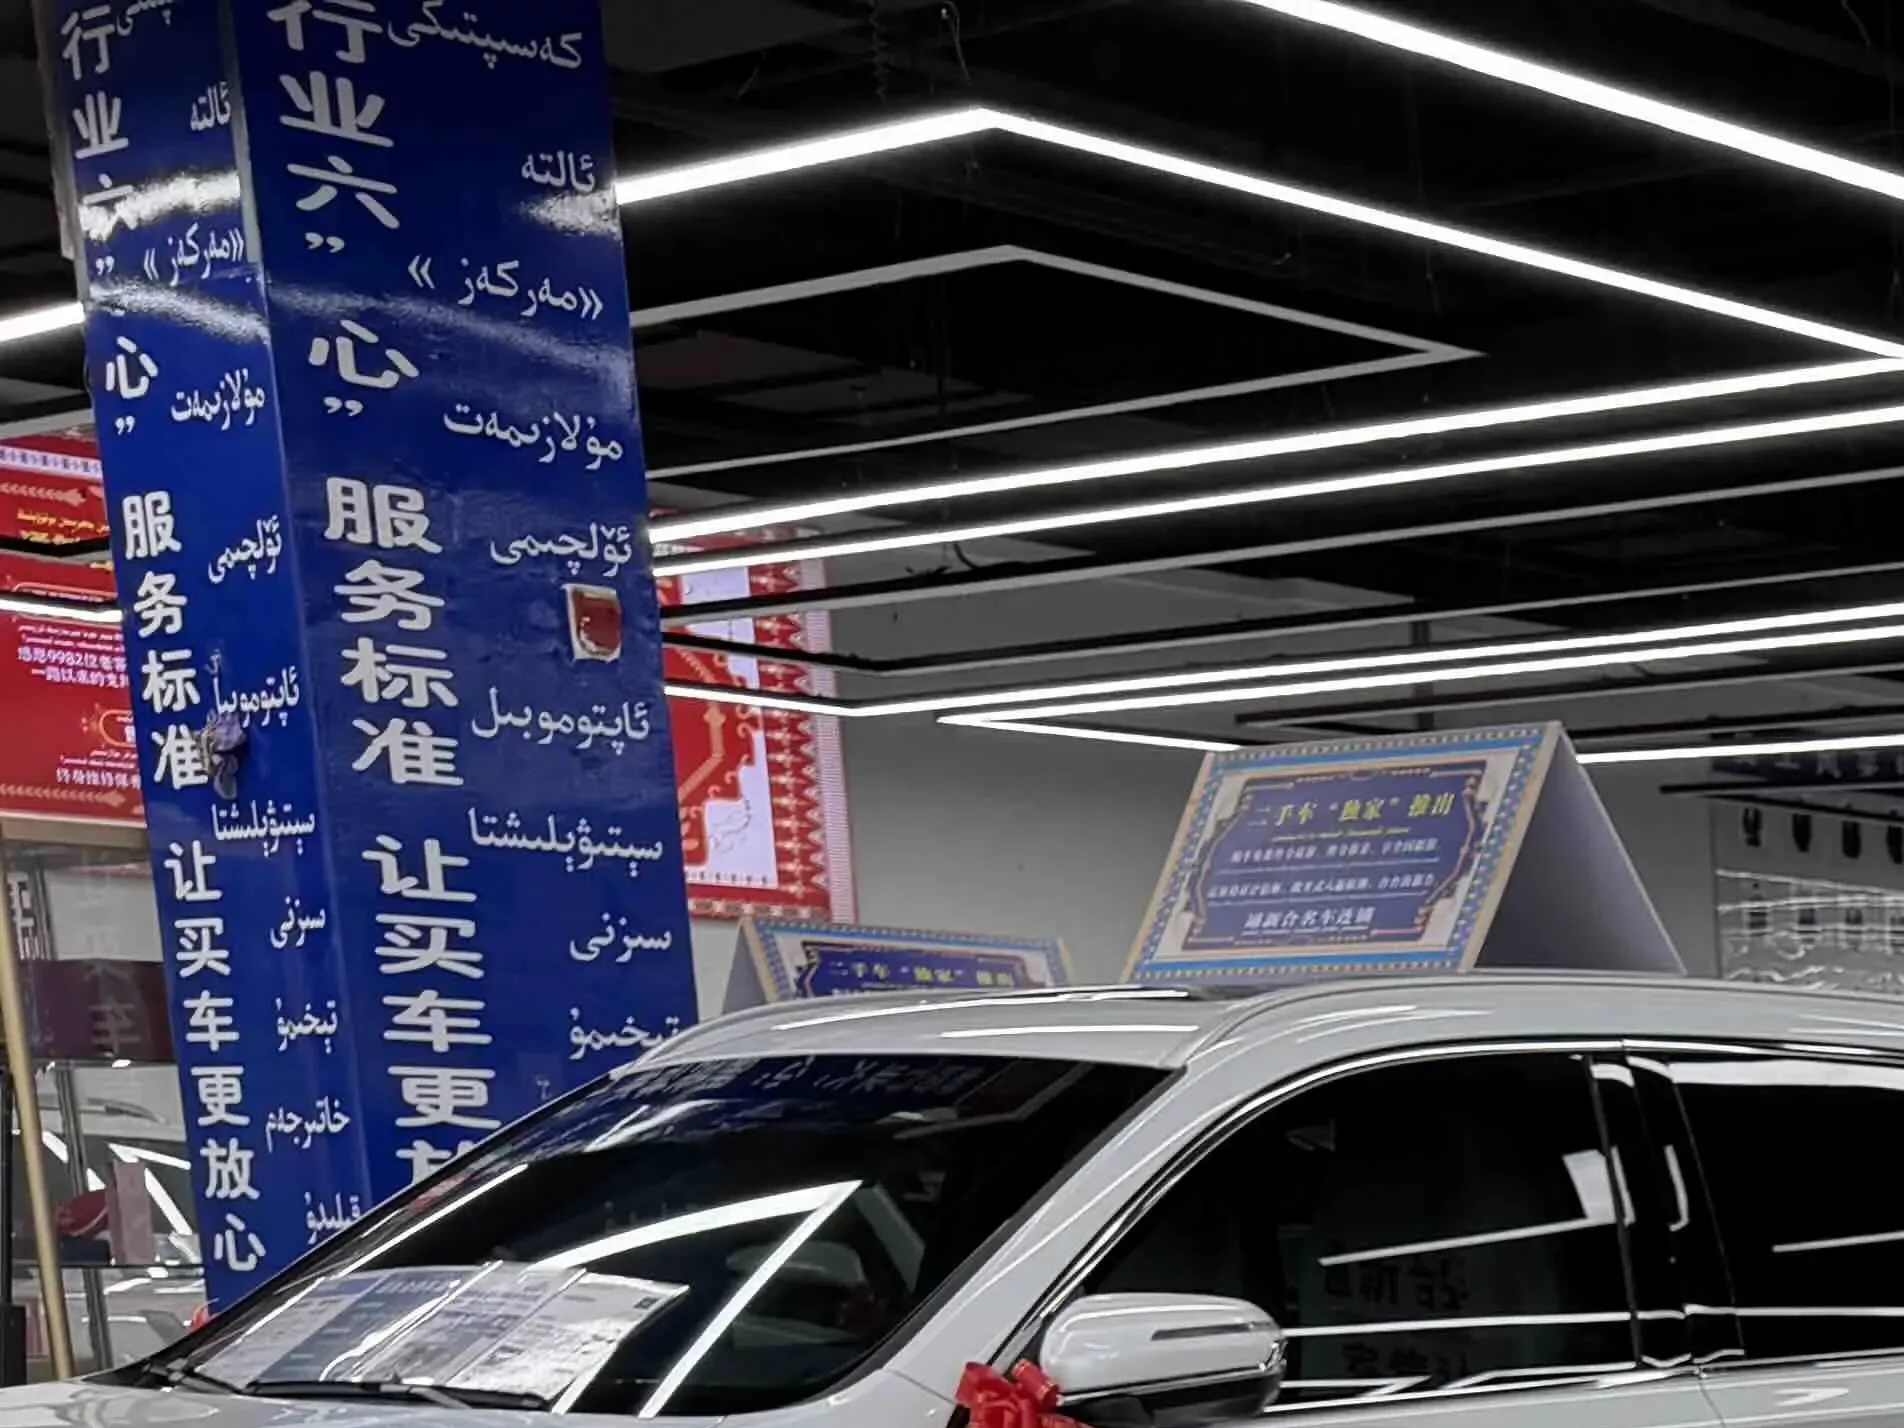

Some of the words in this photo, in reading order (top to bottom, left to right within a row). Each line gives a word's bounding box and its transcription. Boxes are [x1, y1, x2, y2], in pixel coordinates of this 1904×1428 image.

[191, 81, 232, 131] ئالتە
[520, 150, 597, 193] ئالتە
[443, 403, 624, 470] مۇلازىمەت
[471, 686, 651, 756] ئاپتوموبىل
[568, 911, 674, 962] سىزنى
